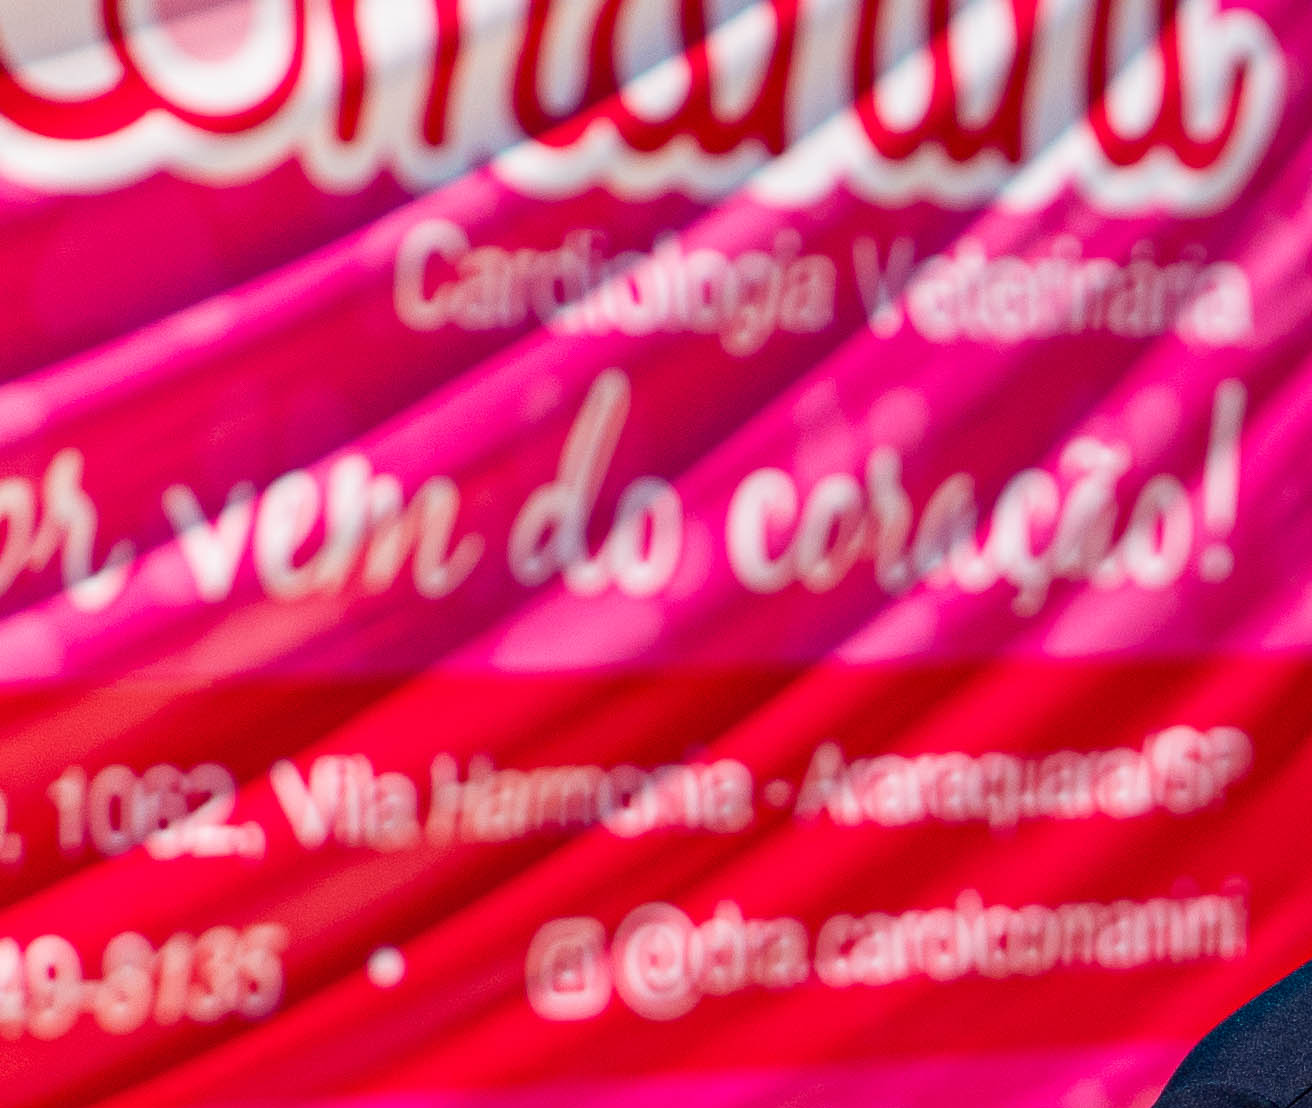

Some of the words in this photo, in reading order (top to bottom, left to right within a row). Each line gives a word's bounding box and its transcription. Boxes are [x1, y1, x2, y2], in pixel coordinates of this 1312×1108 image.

[396, 220, 836, 354] Cardiologia
[852, 236, 1254, 342] Veterinária
[162, 454, 486, 600] vem
[506, 368, 684, 594] do
[726, 378, 1246, 616] coração!
[424, 752, 754, 846] Harmonia
